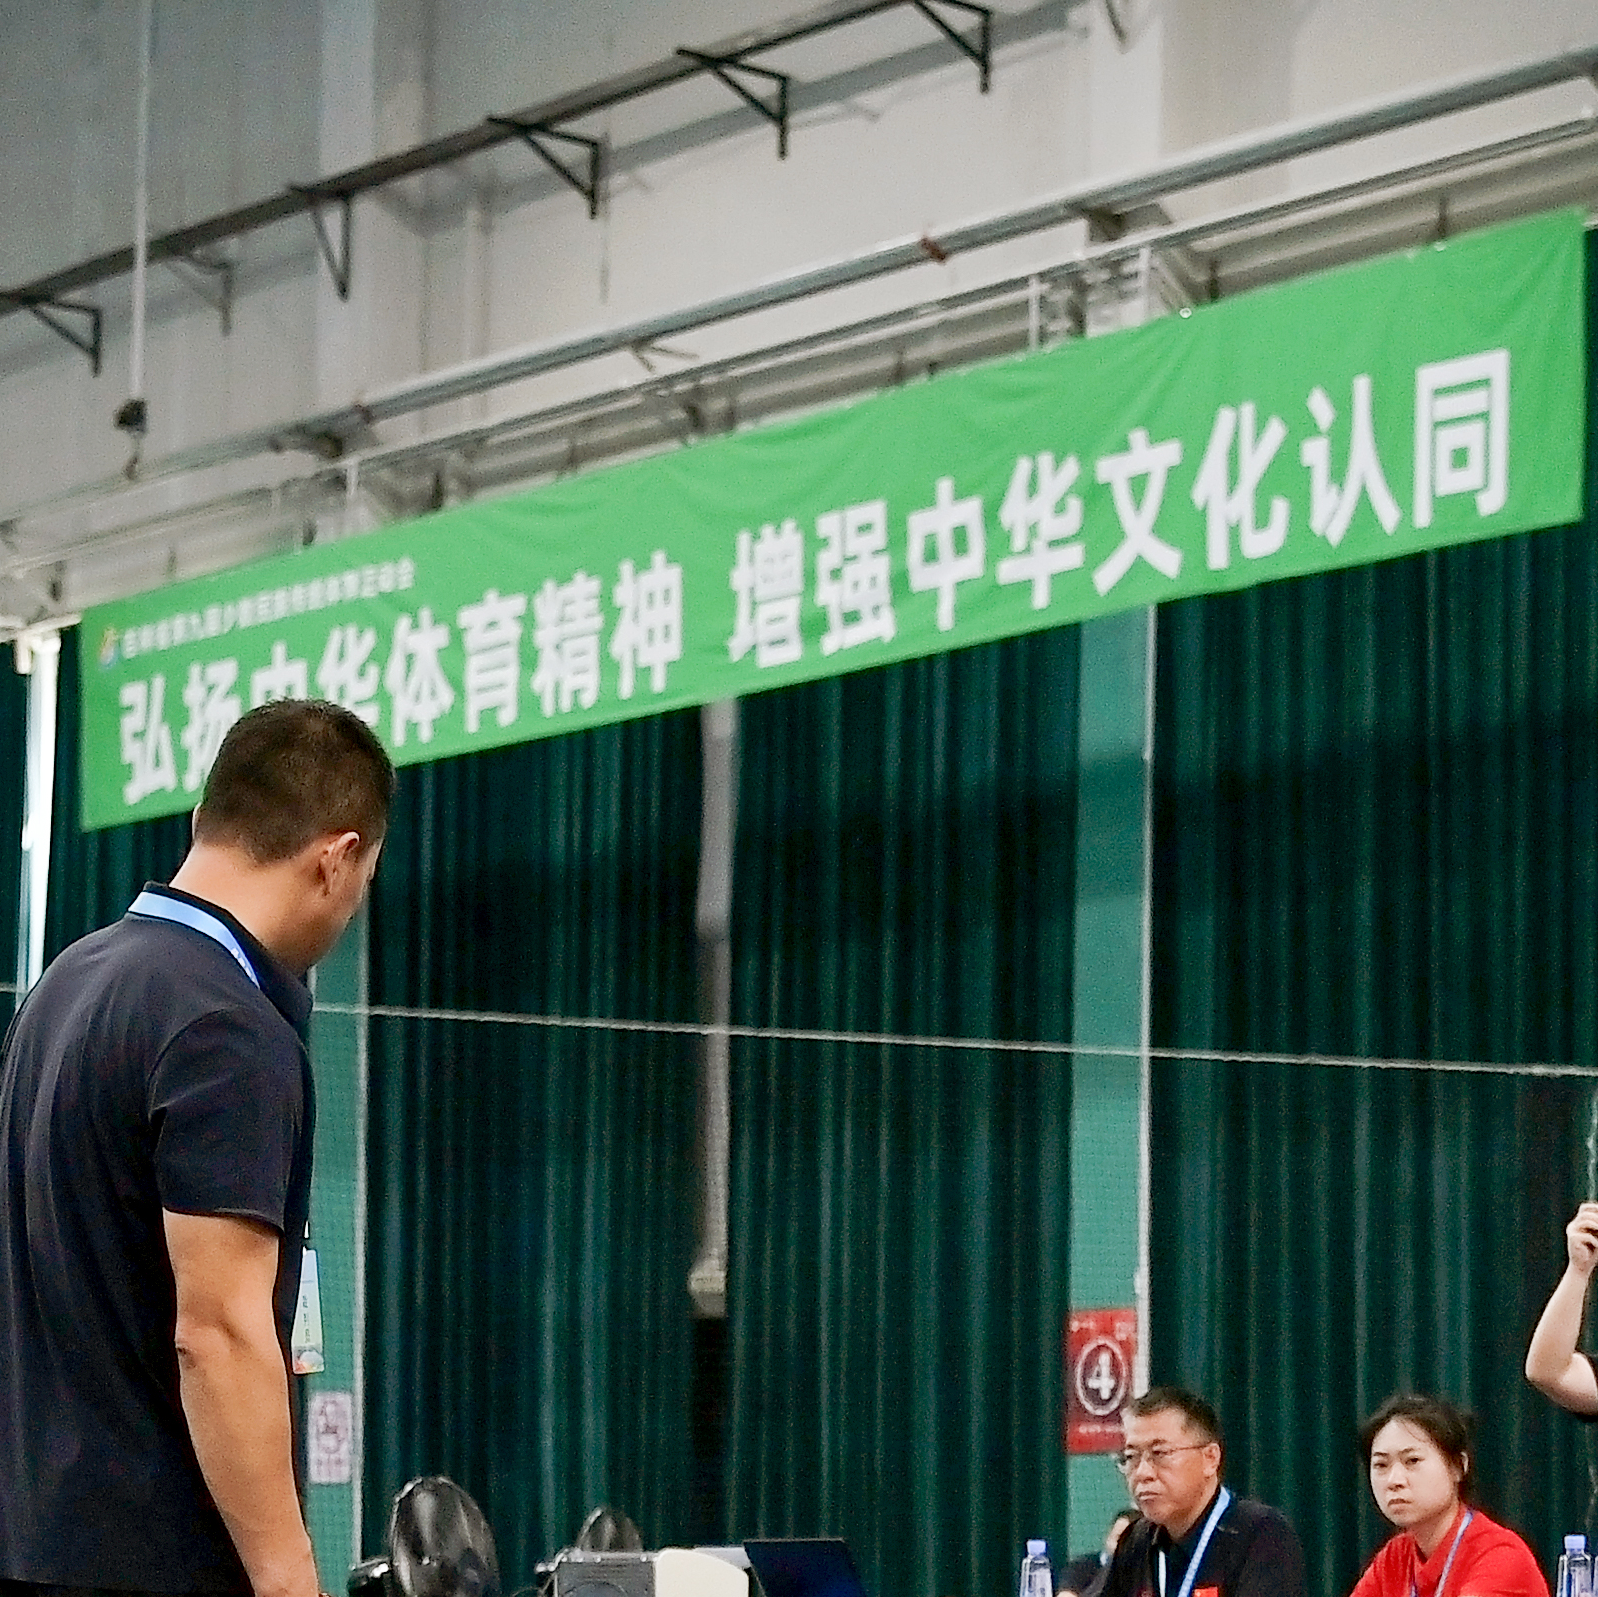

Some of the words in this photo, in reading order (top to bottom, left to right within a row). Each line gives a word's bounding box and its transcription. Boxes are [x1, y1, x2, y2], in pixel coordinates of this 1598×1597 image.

[729, 347, 1512, 671] 增强中华文化认同
[1087, 1351, 1115, 1400] 4
